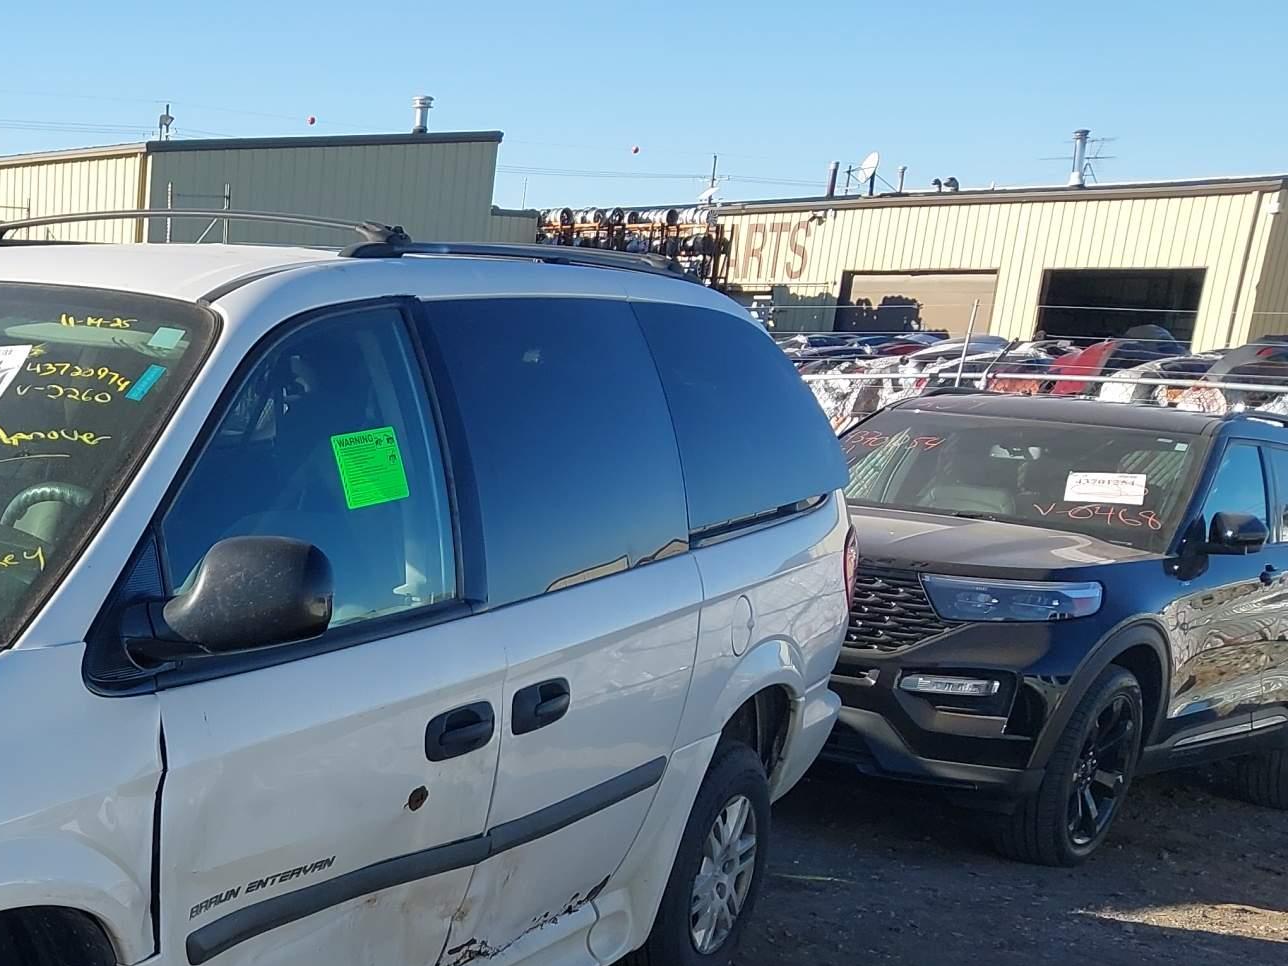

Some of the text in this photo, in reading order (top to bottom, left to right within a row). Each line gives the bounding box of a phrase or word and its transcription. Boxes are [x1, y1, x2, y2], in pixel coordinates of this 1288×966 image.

[26, 361, 131, 392] 43720974
[336, 433, 374, 447] WARNING
[188, 855, 337, 920] BRAUN ENTERVAN
